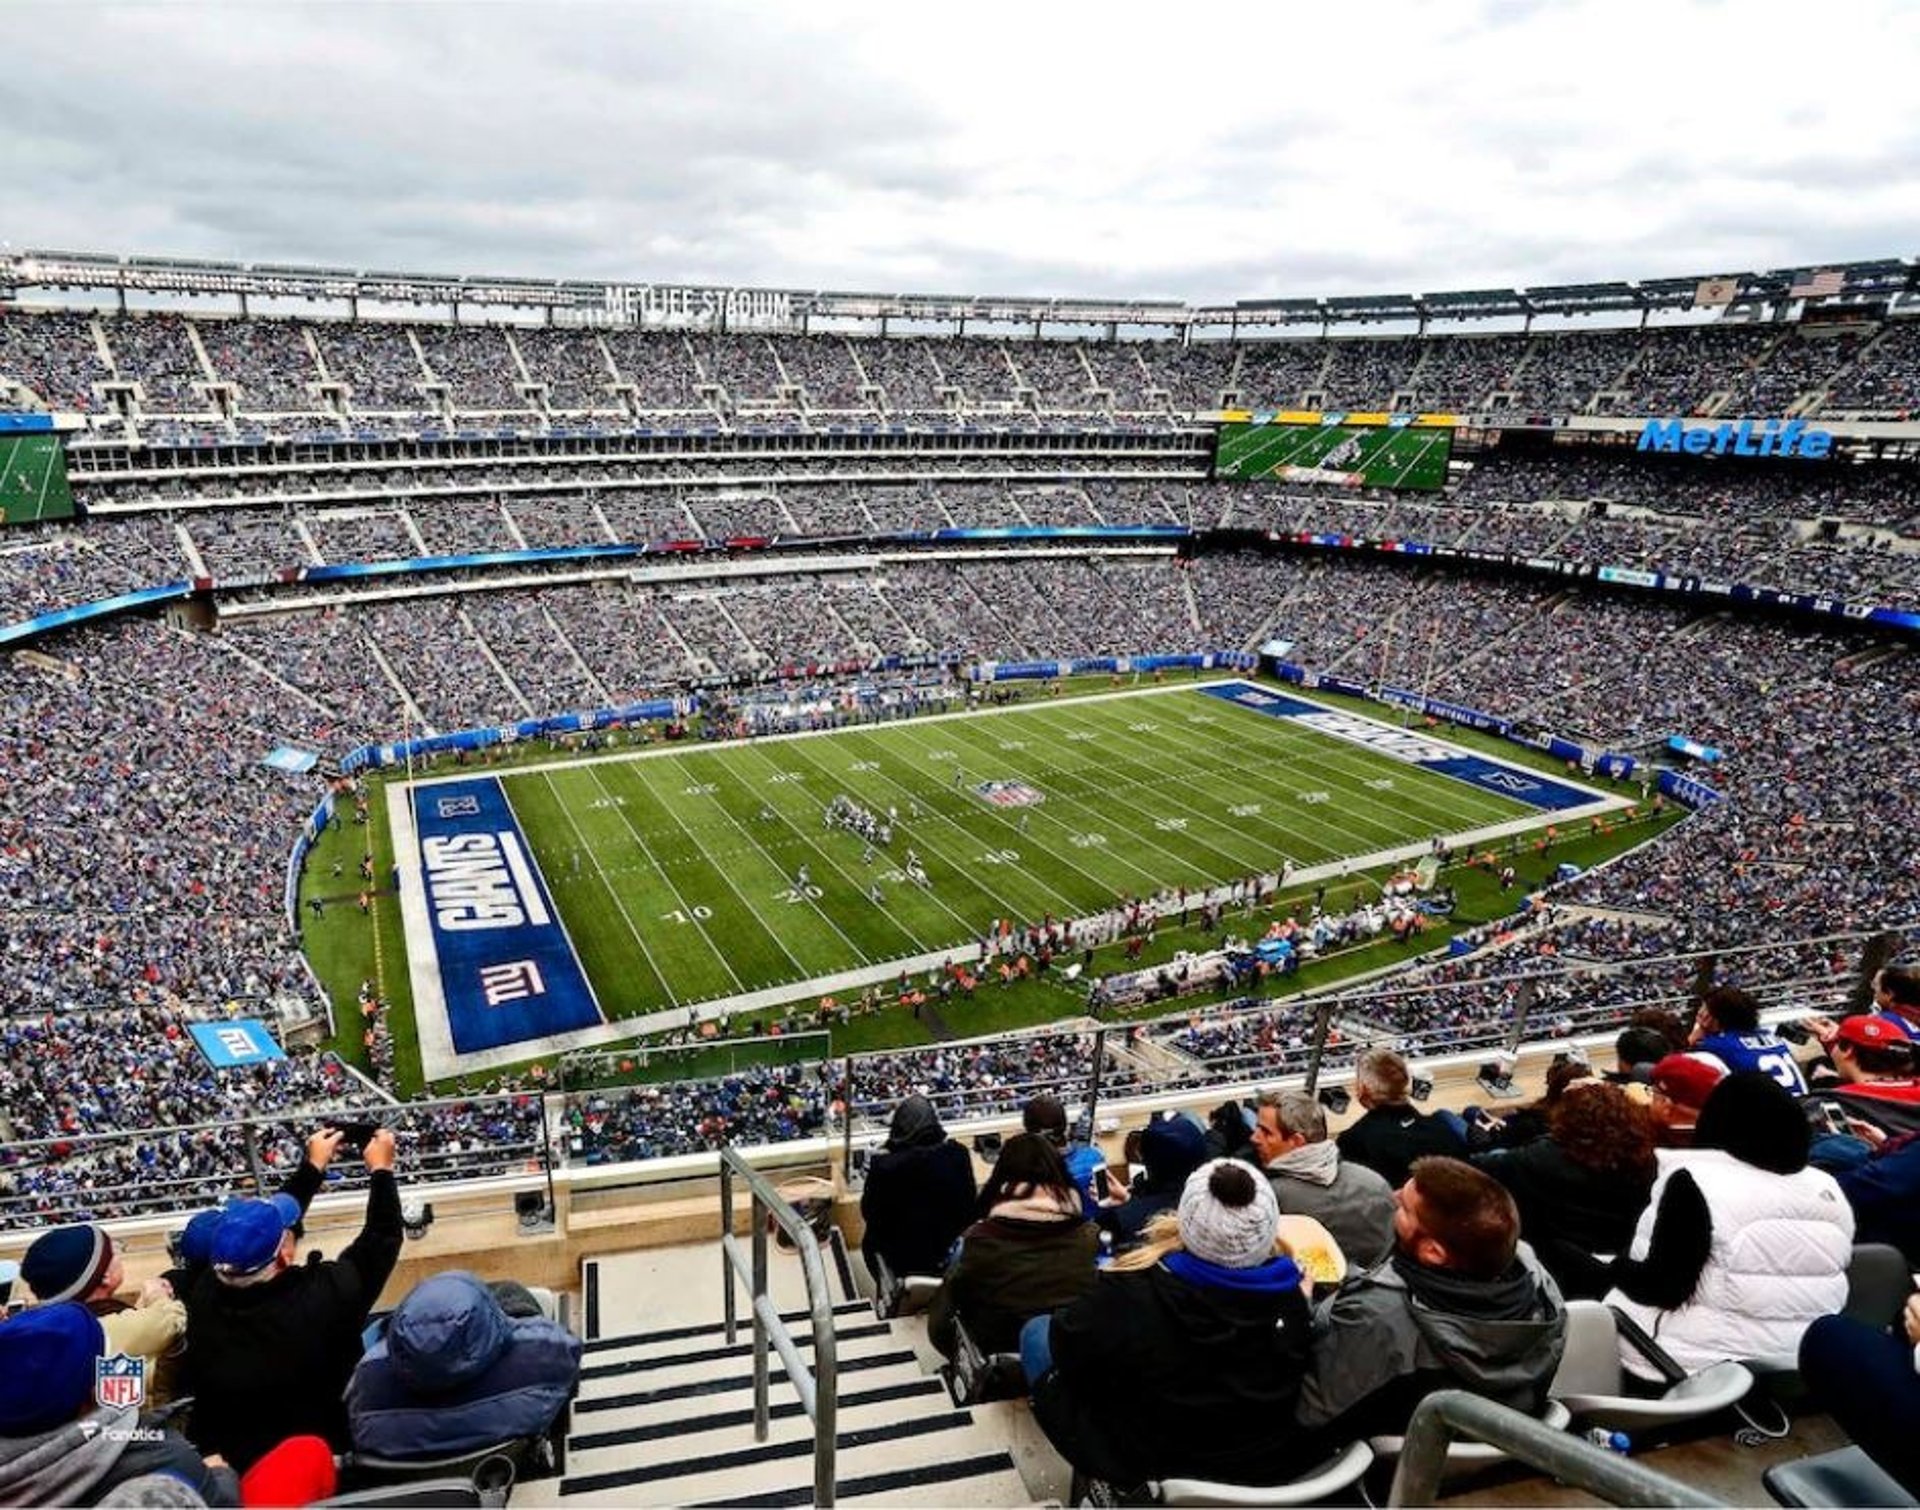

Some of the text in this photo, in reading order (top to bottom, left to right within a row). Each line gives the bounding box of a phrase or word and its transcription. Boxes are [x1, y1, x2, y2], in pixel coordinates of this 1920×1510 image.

[702, 290, 790, 318] STADIUM
[1637, 418, 1831, 458] MetLife
[422, 832, 526, 932] GIANTS
